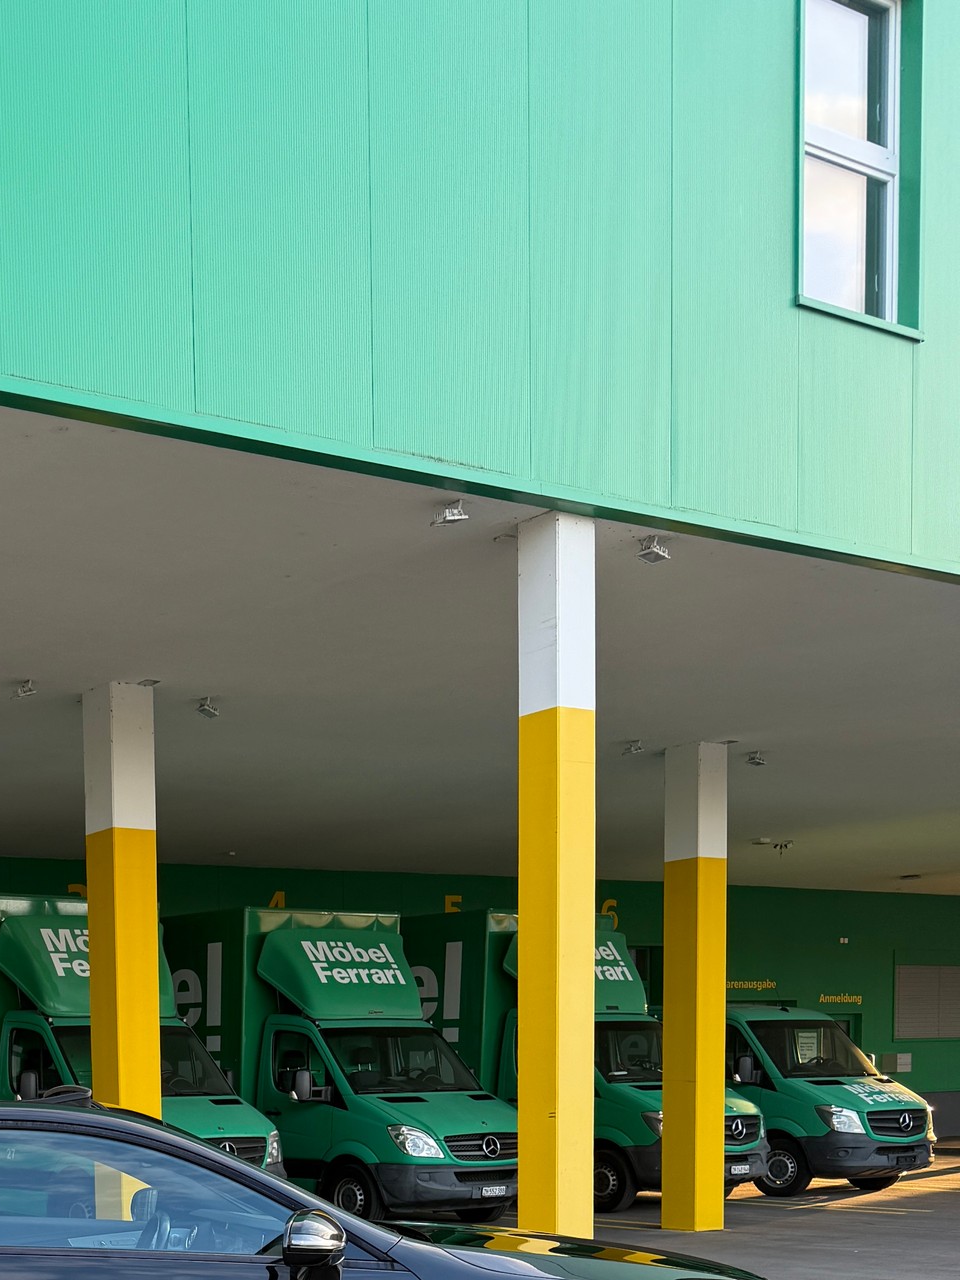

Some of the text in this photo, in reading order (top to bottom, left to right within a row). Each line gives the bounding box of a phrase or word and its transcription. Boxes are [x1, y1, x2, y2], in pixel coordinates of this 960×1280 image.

[300, 940, 395, 963] Möbel
[312, 962, 406, 985] Ferrari
[595, 961, 633, 981] rari
[726, 979, 777, 991] arenausgabe
[819, 993, 863, 1005] Anmeldung
